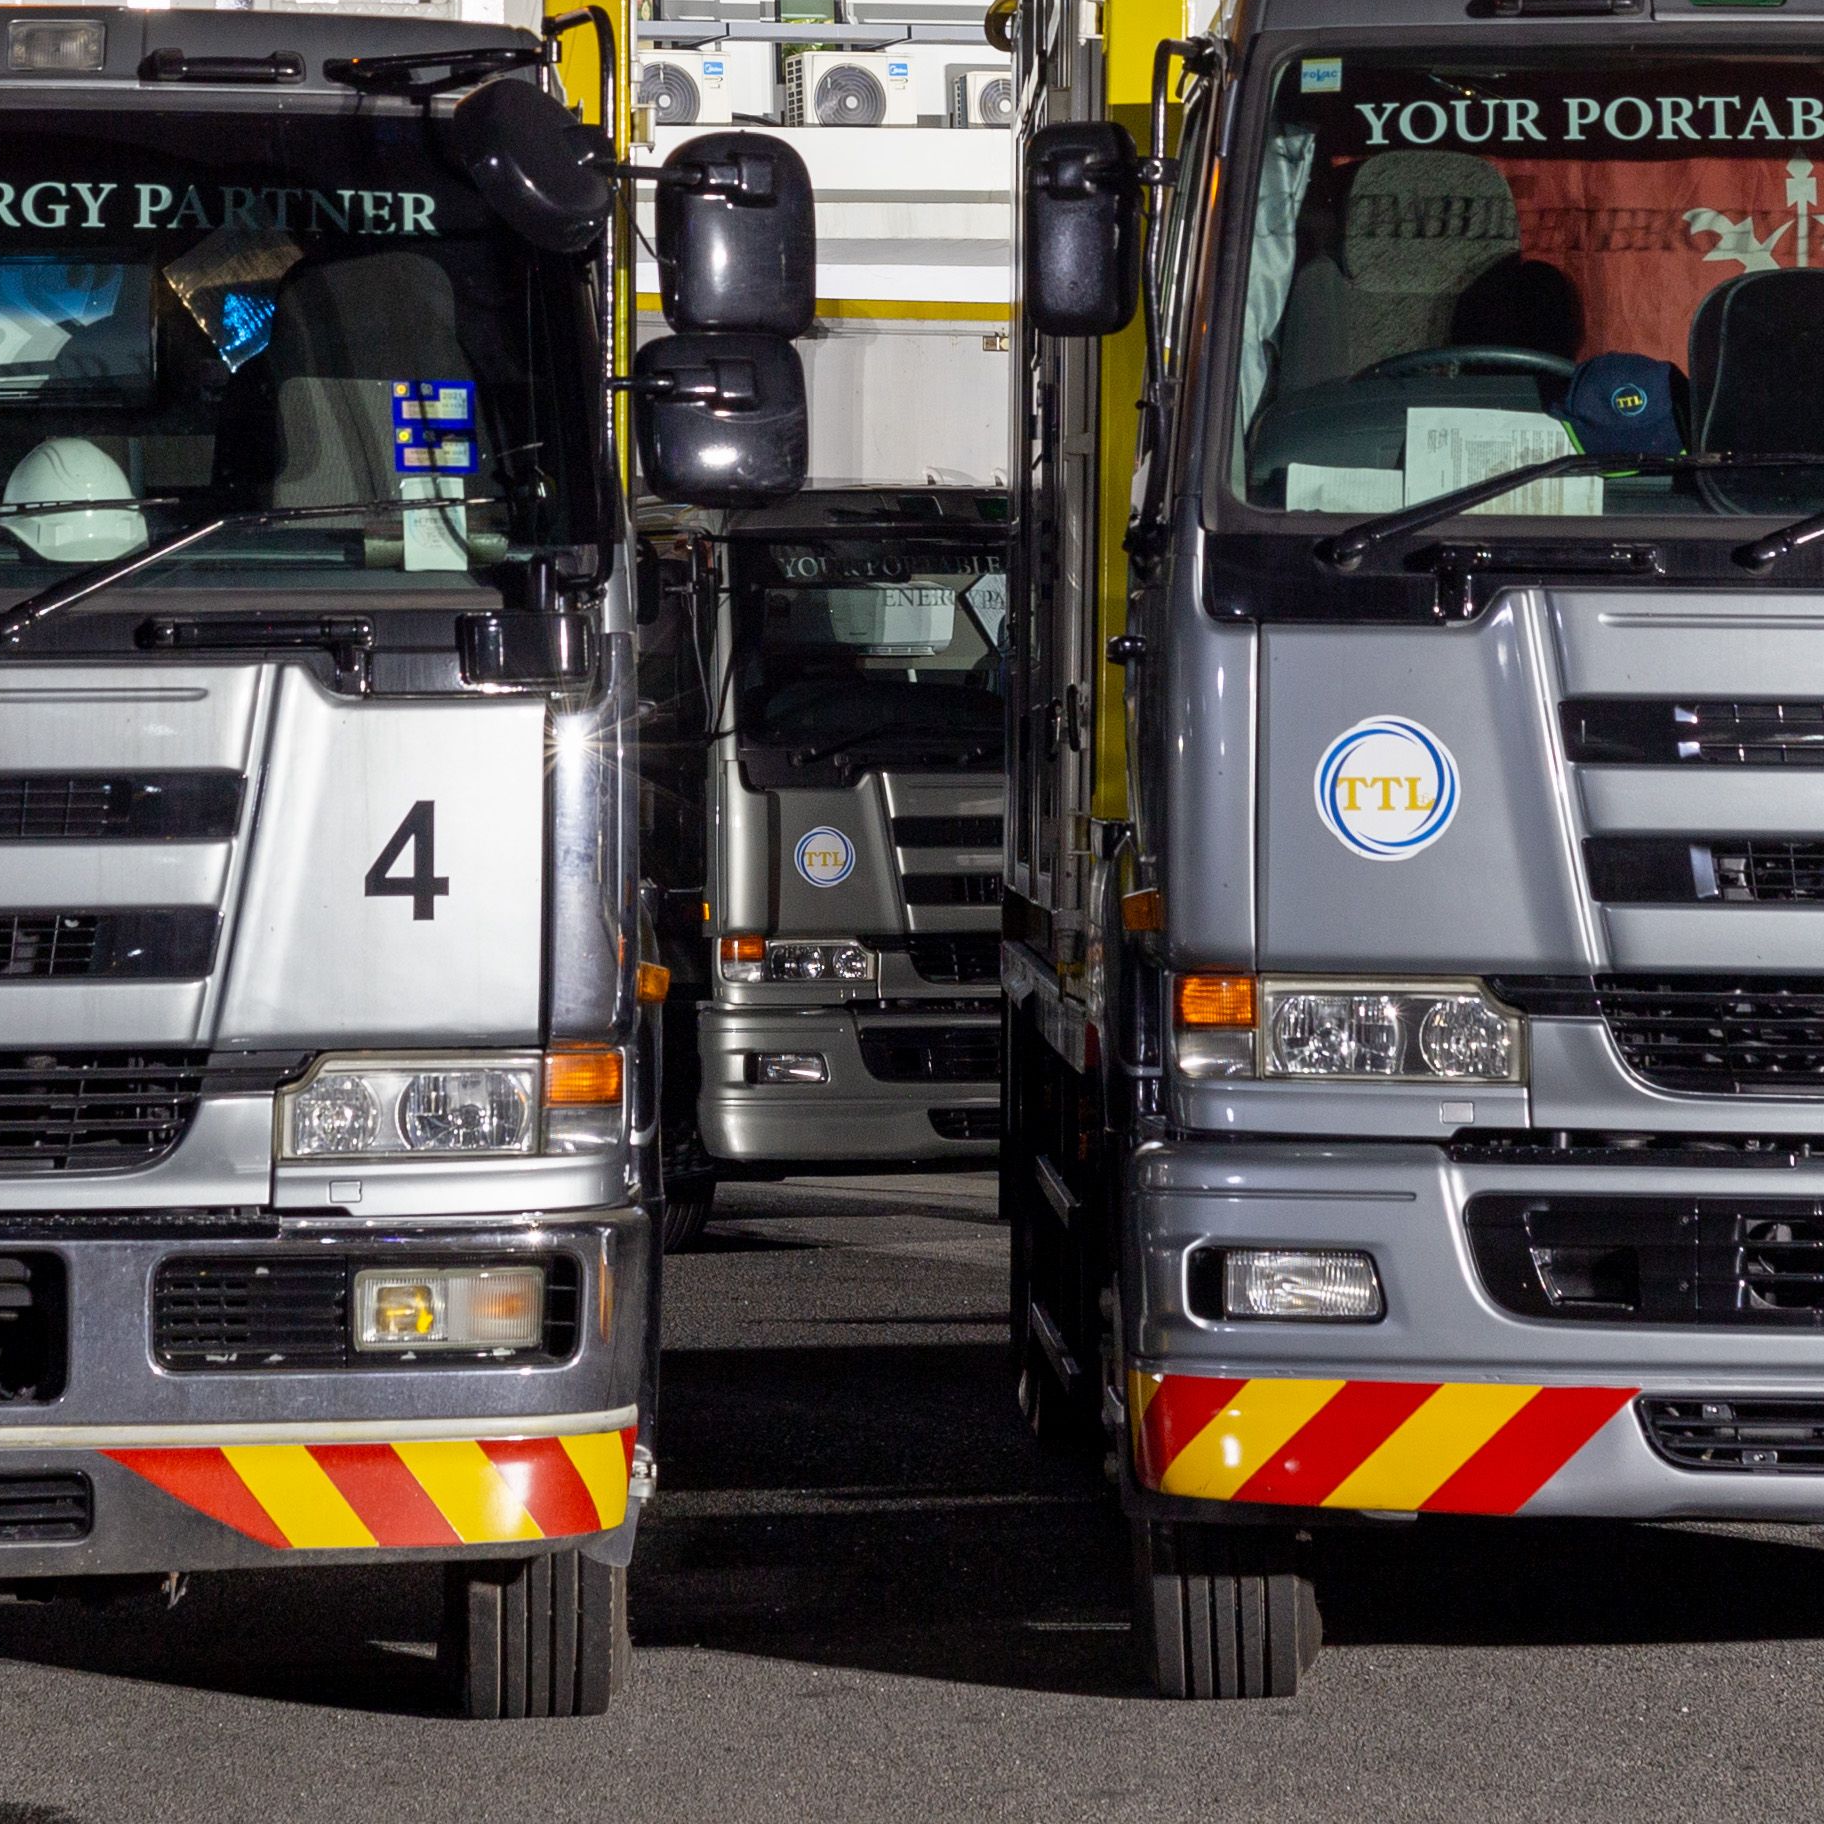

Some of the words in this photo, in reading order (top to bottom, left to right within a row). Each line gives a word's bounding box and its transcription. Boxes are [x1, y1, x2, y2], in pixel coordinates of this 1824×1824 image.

[1355, 98, 1549, 148] YOUR
[134, 184, 439, 236] PARTNER
[1616, 394, 1644, 410] TTL
[1336, 774, 1438, 814] TTL
[363, 799, 451, 922] 4
[803, 850, 844, 868] TTL
